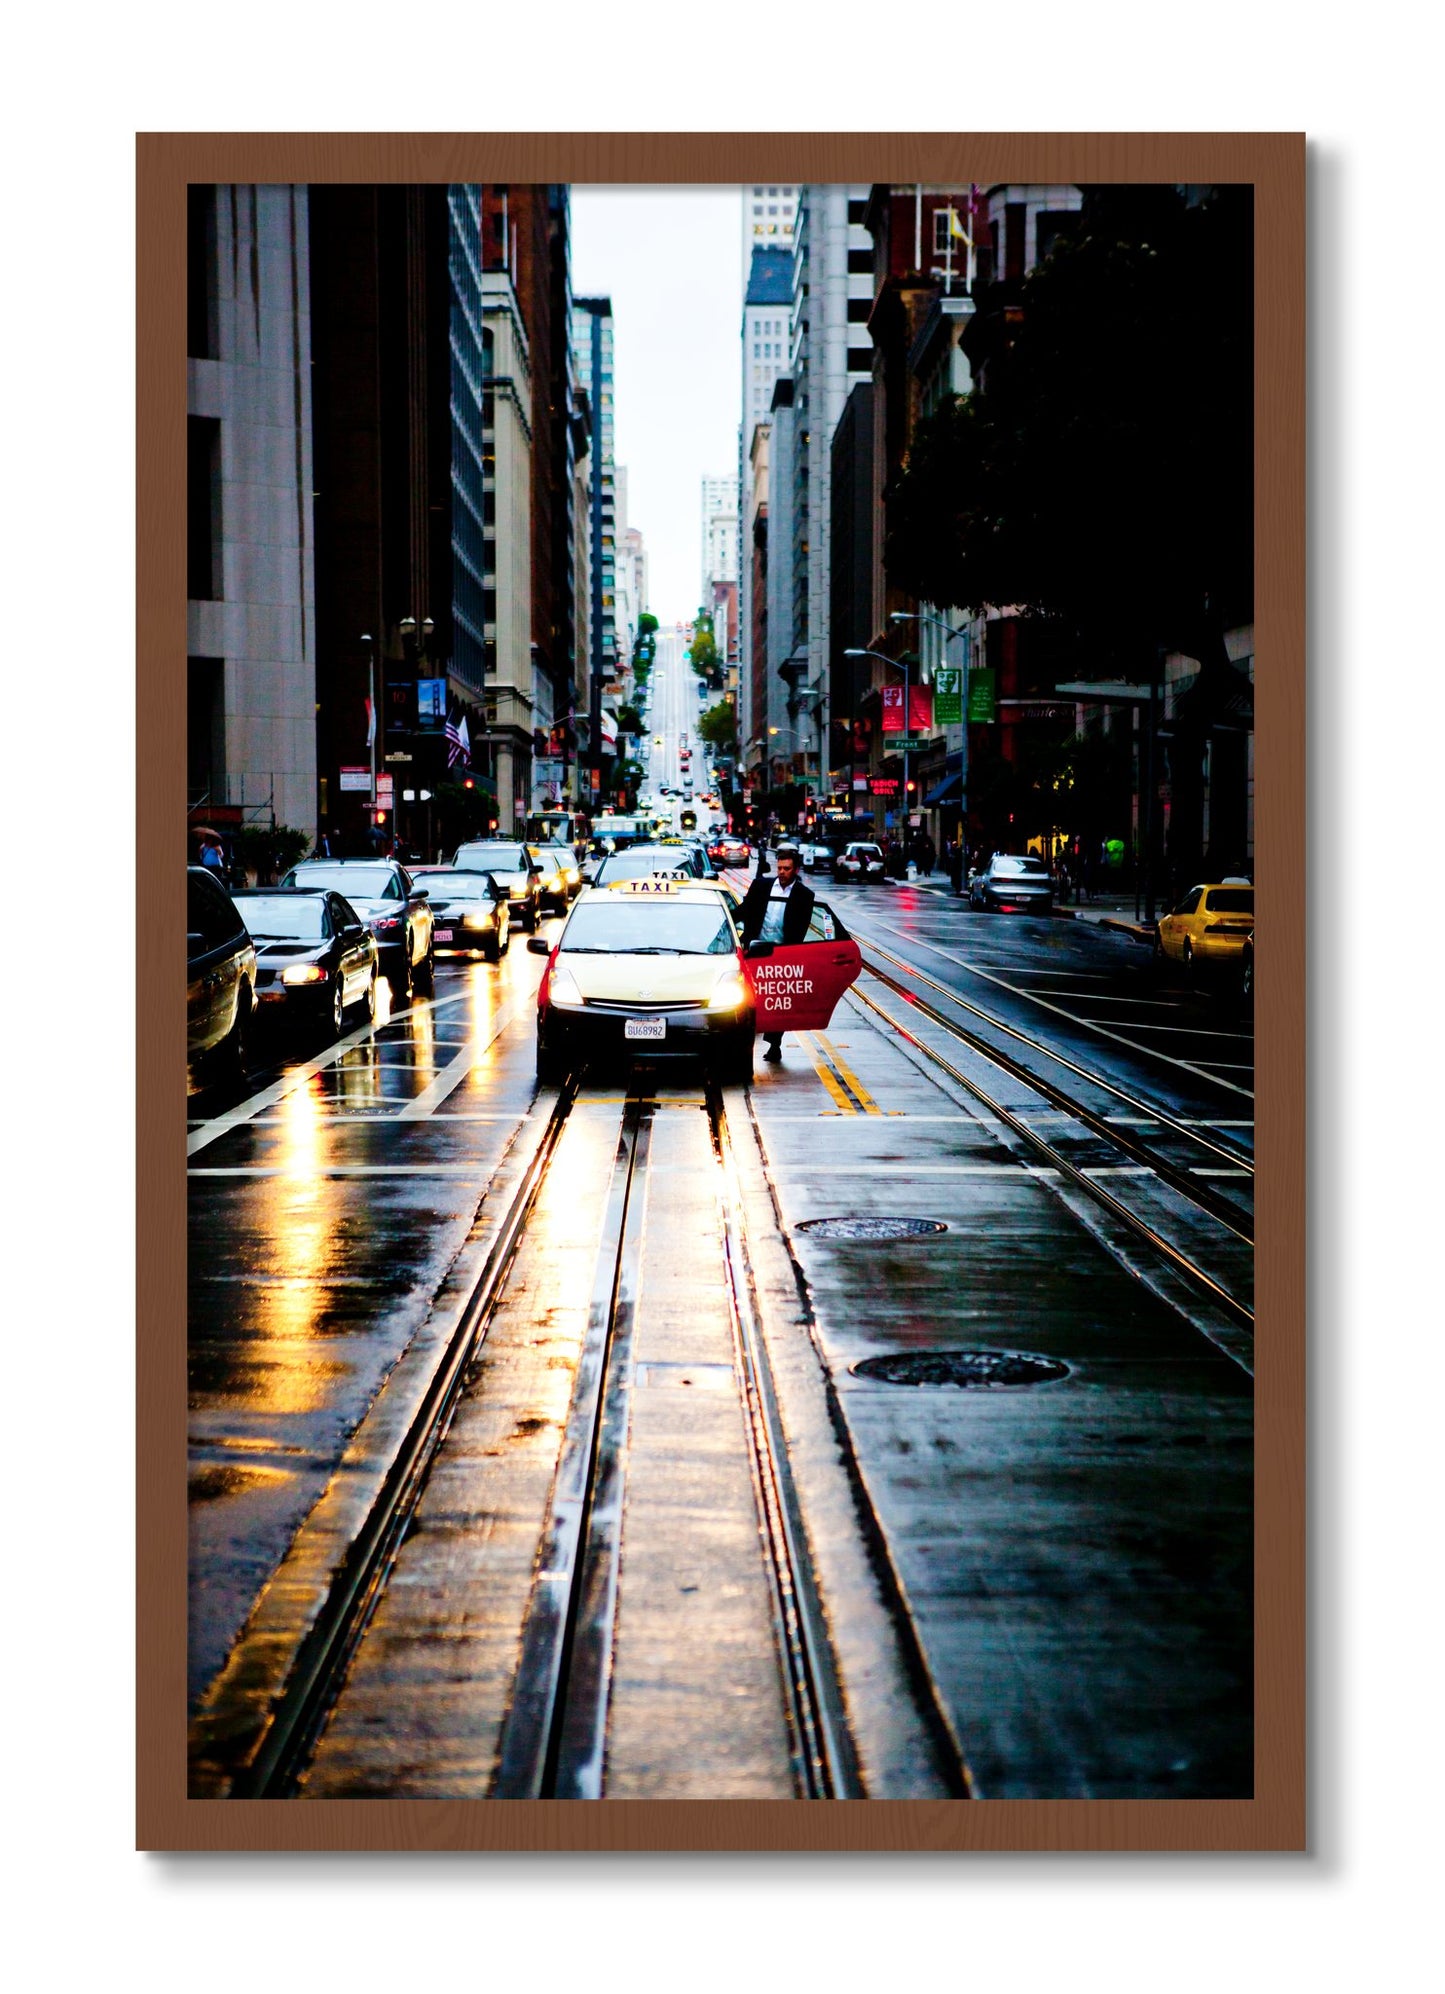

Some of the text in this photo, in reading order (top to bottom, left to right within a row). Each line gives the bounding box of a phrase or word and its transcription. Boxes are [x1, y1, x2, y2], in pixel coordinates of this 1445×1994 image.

[870, 779, 898, 787] TADICH
[631, 883, 669, 892] TAXI
[756, 965, 804, 979] ARROW
[764, 997, 792, 1011] CAB
